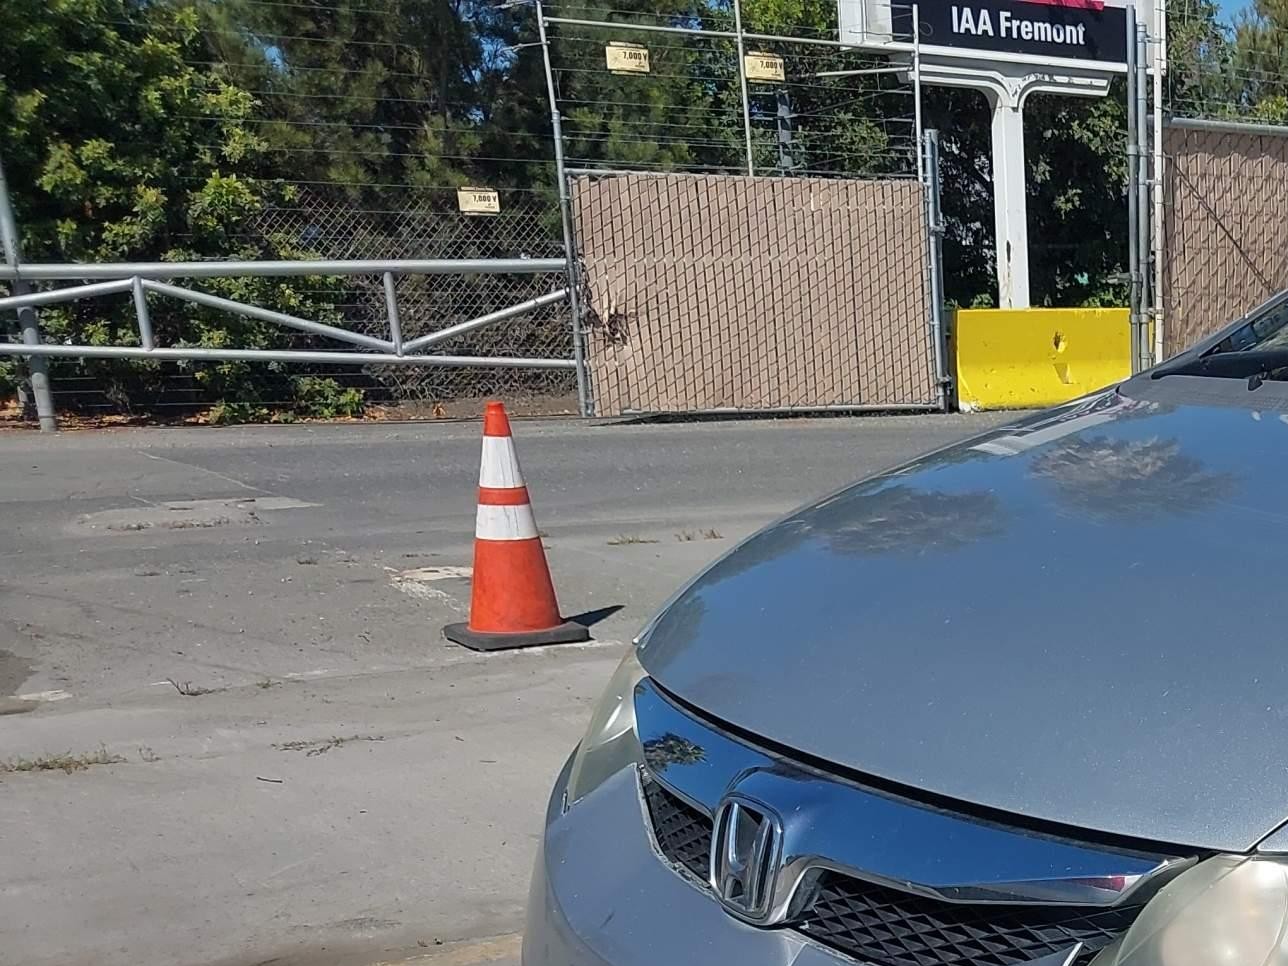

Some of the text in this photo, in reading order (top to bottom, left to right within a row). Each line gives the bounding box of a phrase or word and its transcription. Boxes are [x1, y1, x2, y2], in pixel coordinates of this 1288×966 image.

[951, 6, 1086, 46] IAA Fremont
[622, 51, 642, 60] 7,000
[760, 60, 778, 69] 7,000
[472, 194, 491, 203] 7,000
